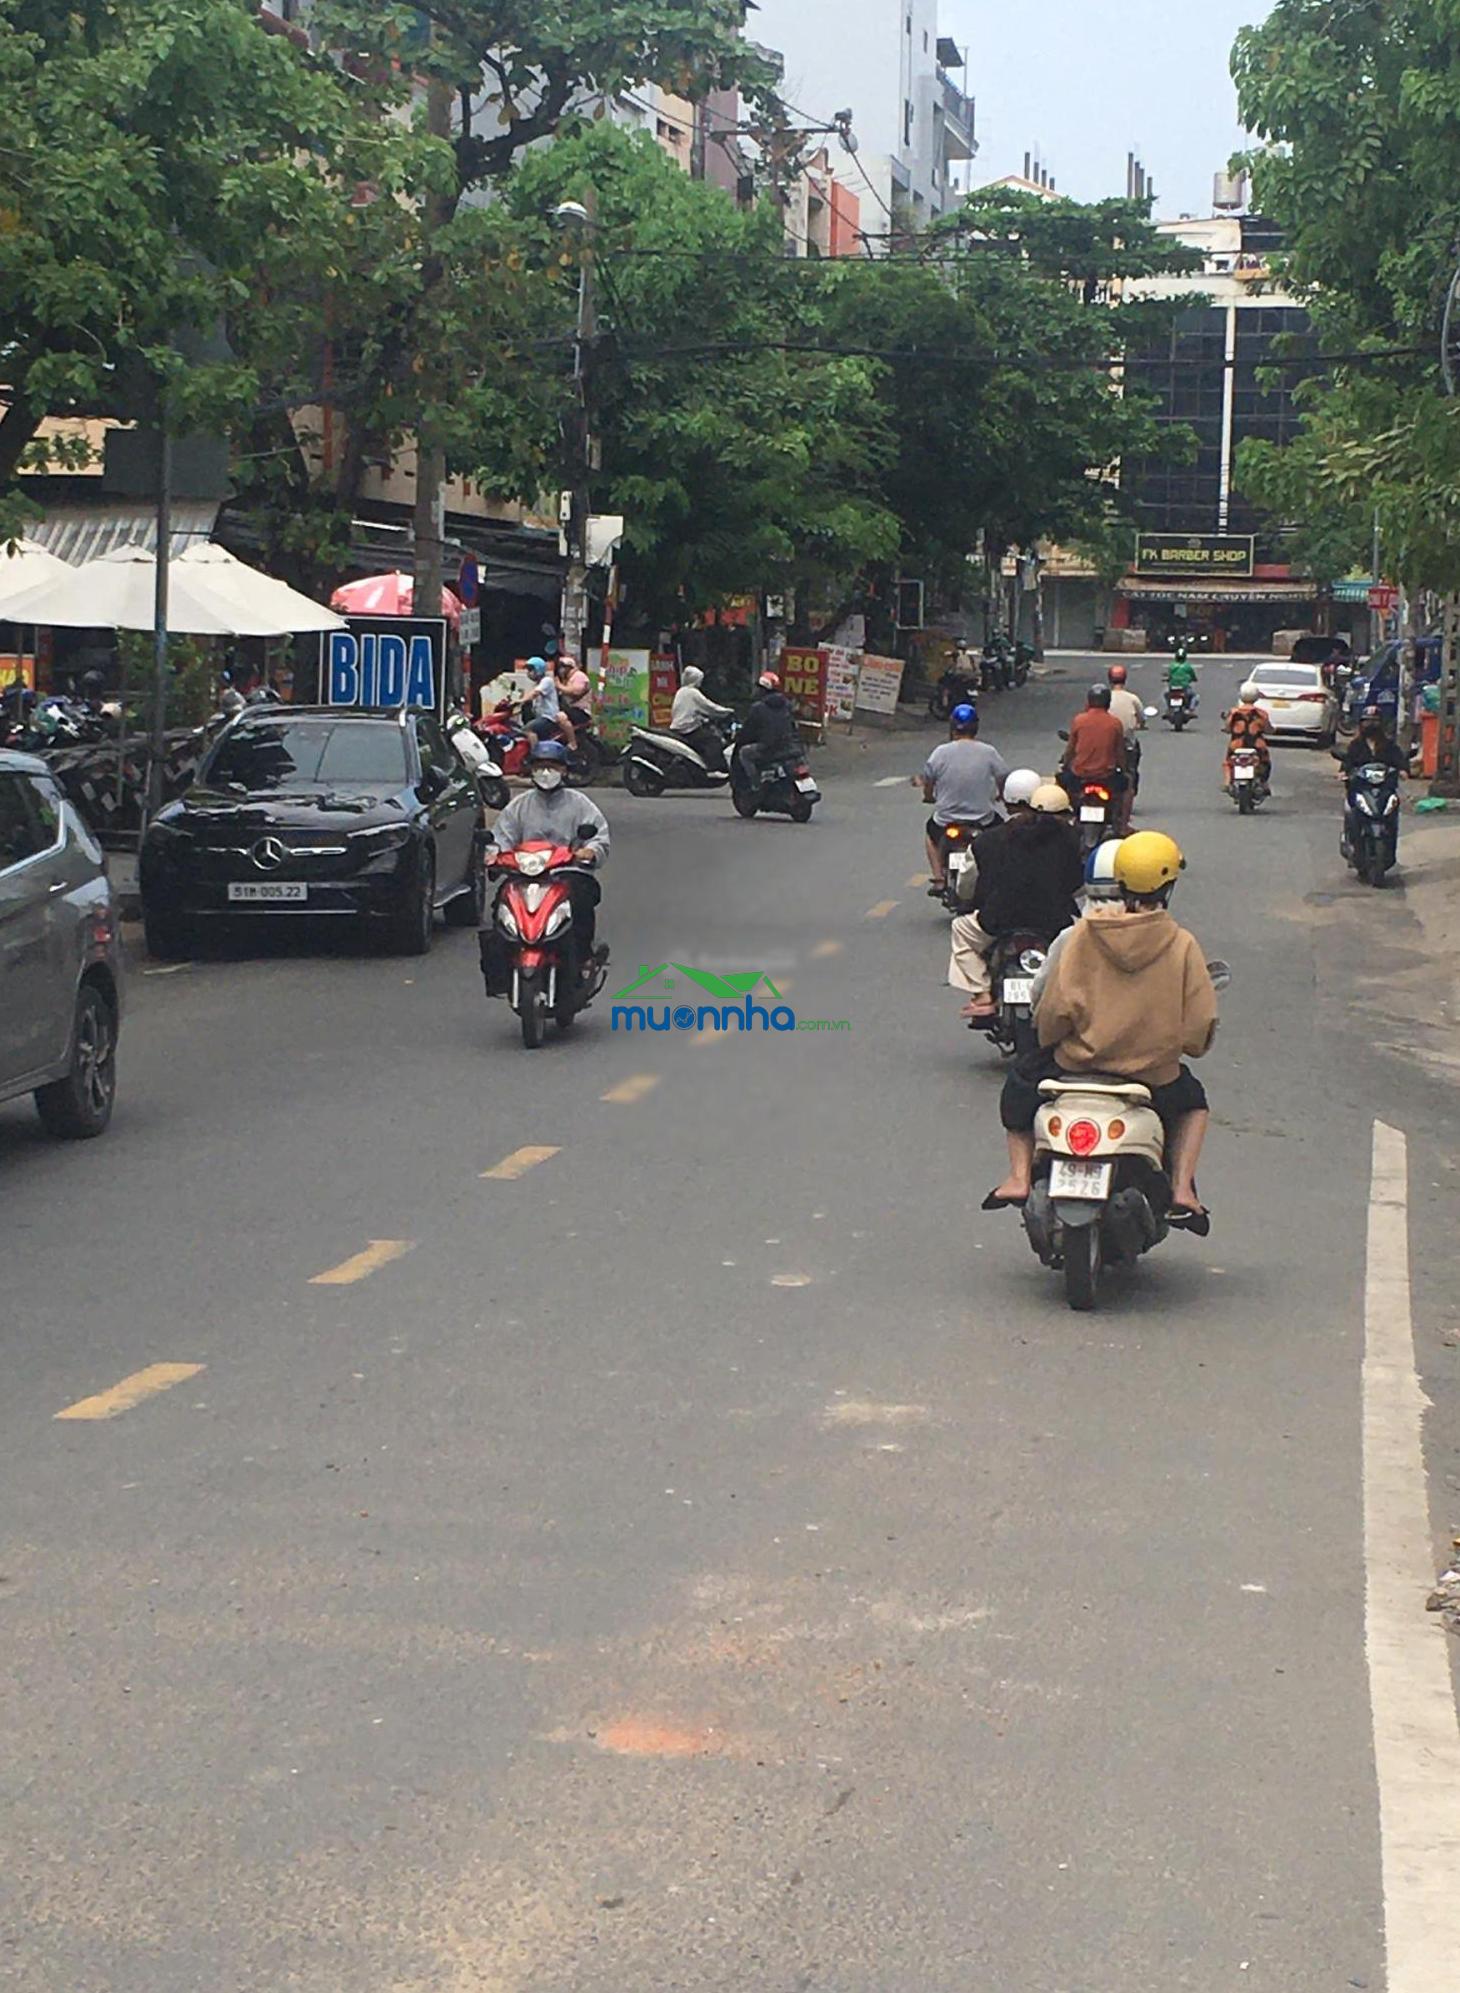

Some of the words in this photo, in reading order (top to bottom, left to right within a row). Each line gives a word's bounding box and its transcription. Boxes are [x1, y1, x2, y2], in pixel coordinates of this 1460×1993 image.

[1161, 549, 1209, 561] BARBER
[1213, 550, 1246, 562] SHOP
[329, 632, 435, 709] BIDA
